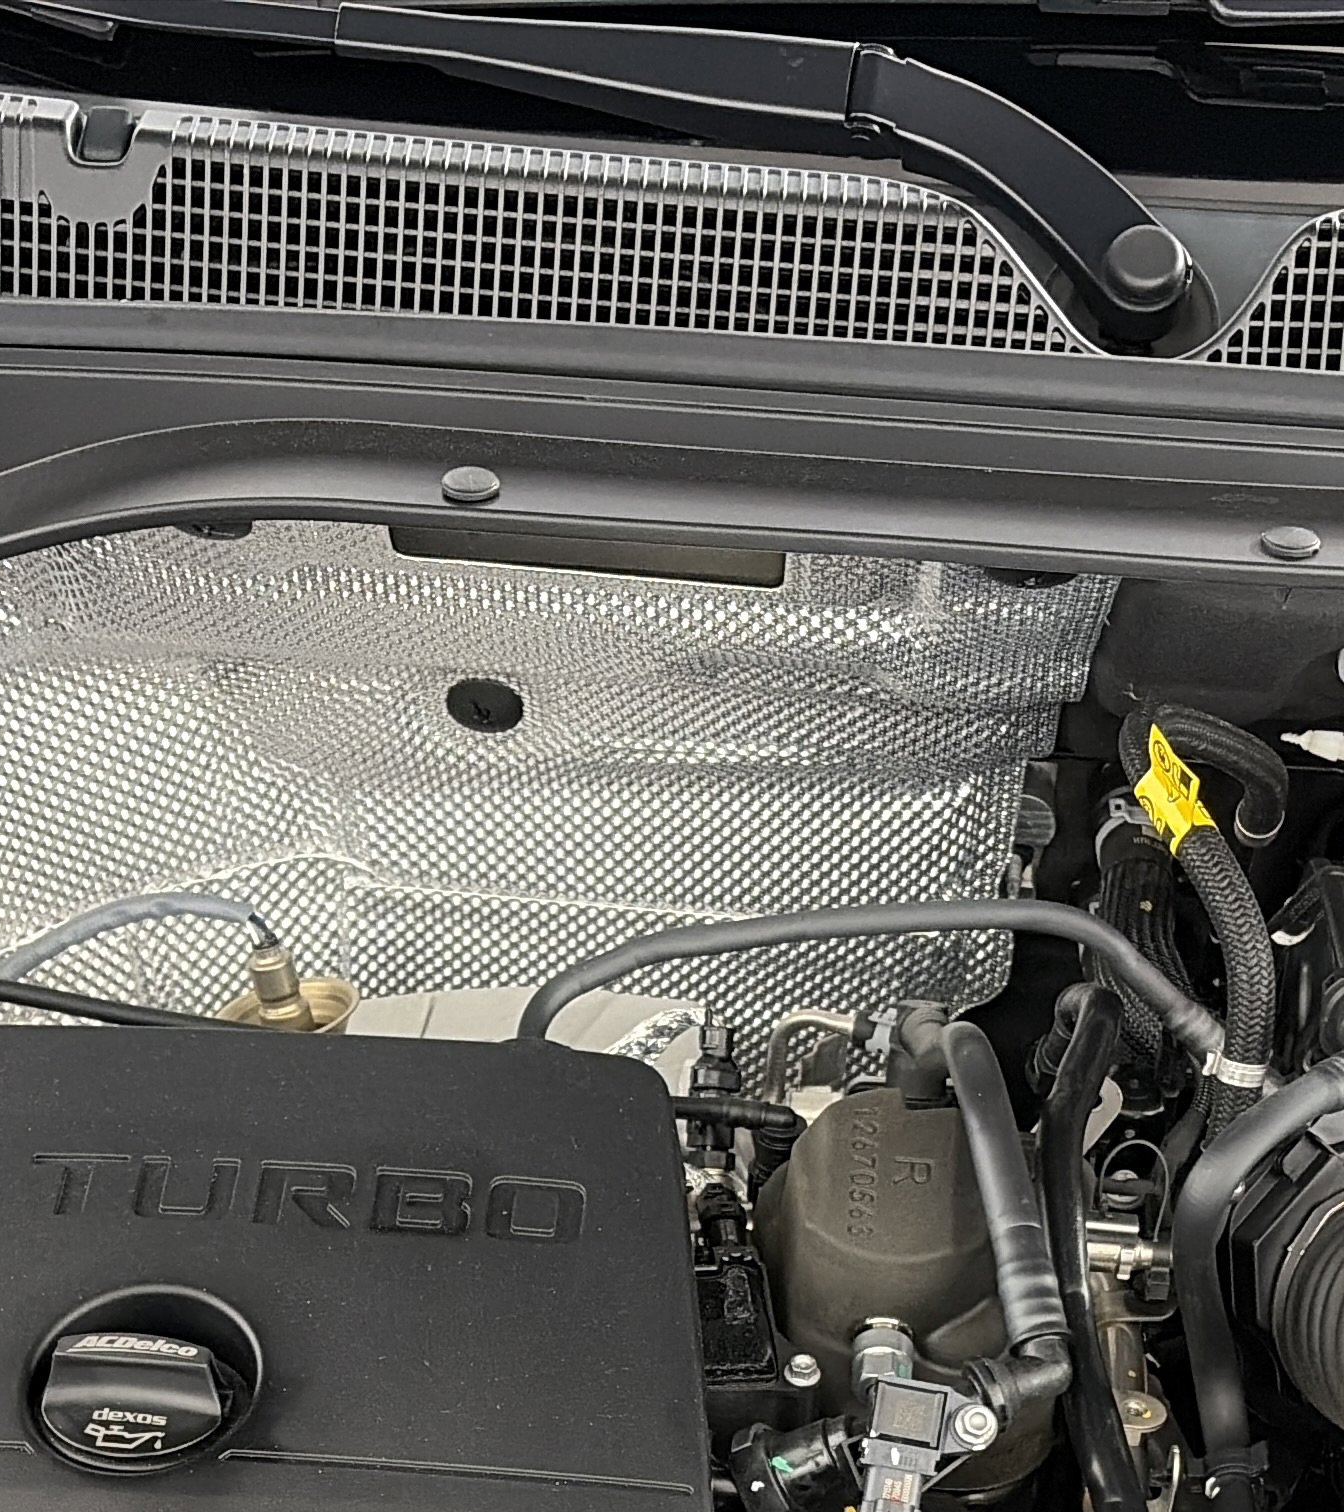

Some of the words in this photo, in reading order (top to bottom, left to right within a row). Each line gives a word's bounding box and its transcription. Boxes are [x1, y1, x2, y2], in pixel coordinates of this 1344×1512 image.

[891, 1155, 936, 1186] R
[32, 1152, 587, 1243] TURBO
[77, 1334, 199, 1359] ACDelco
[91, 1407, 168, 1428] dexos
